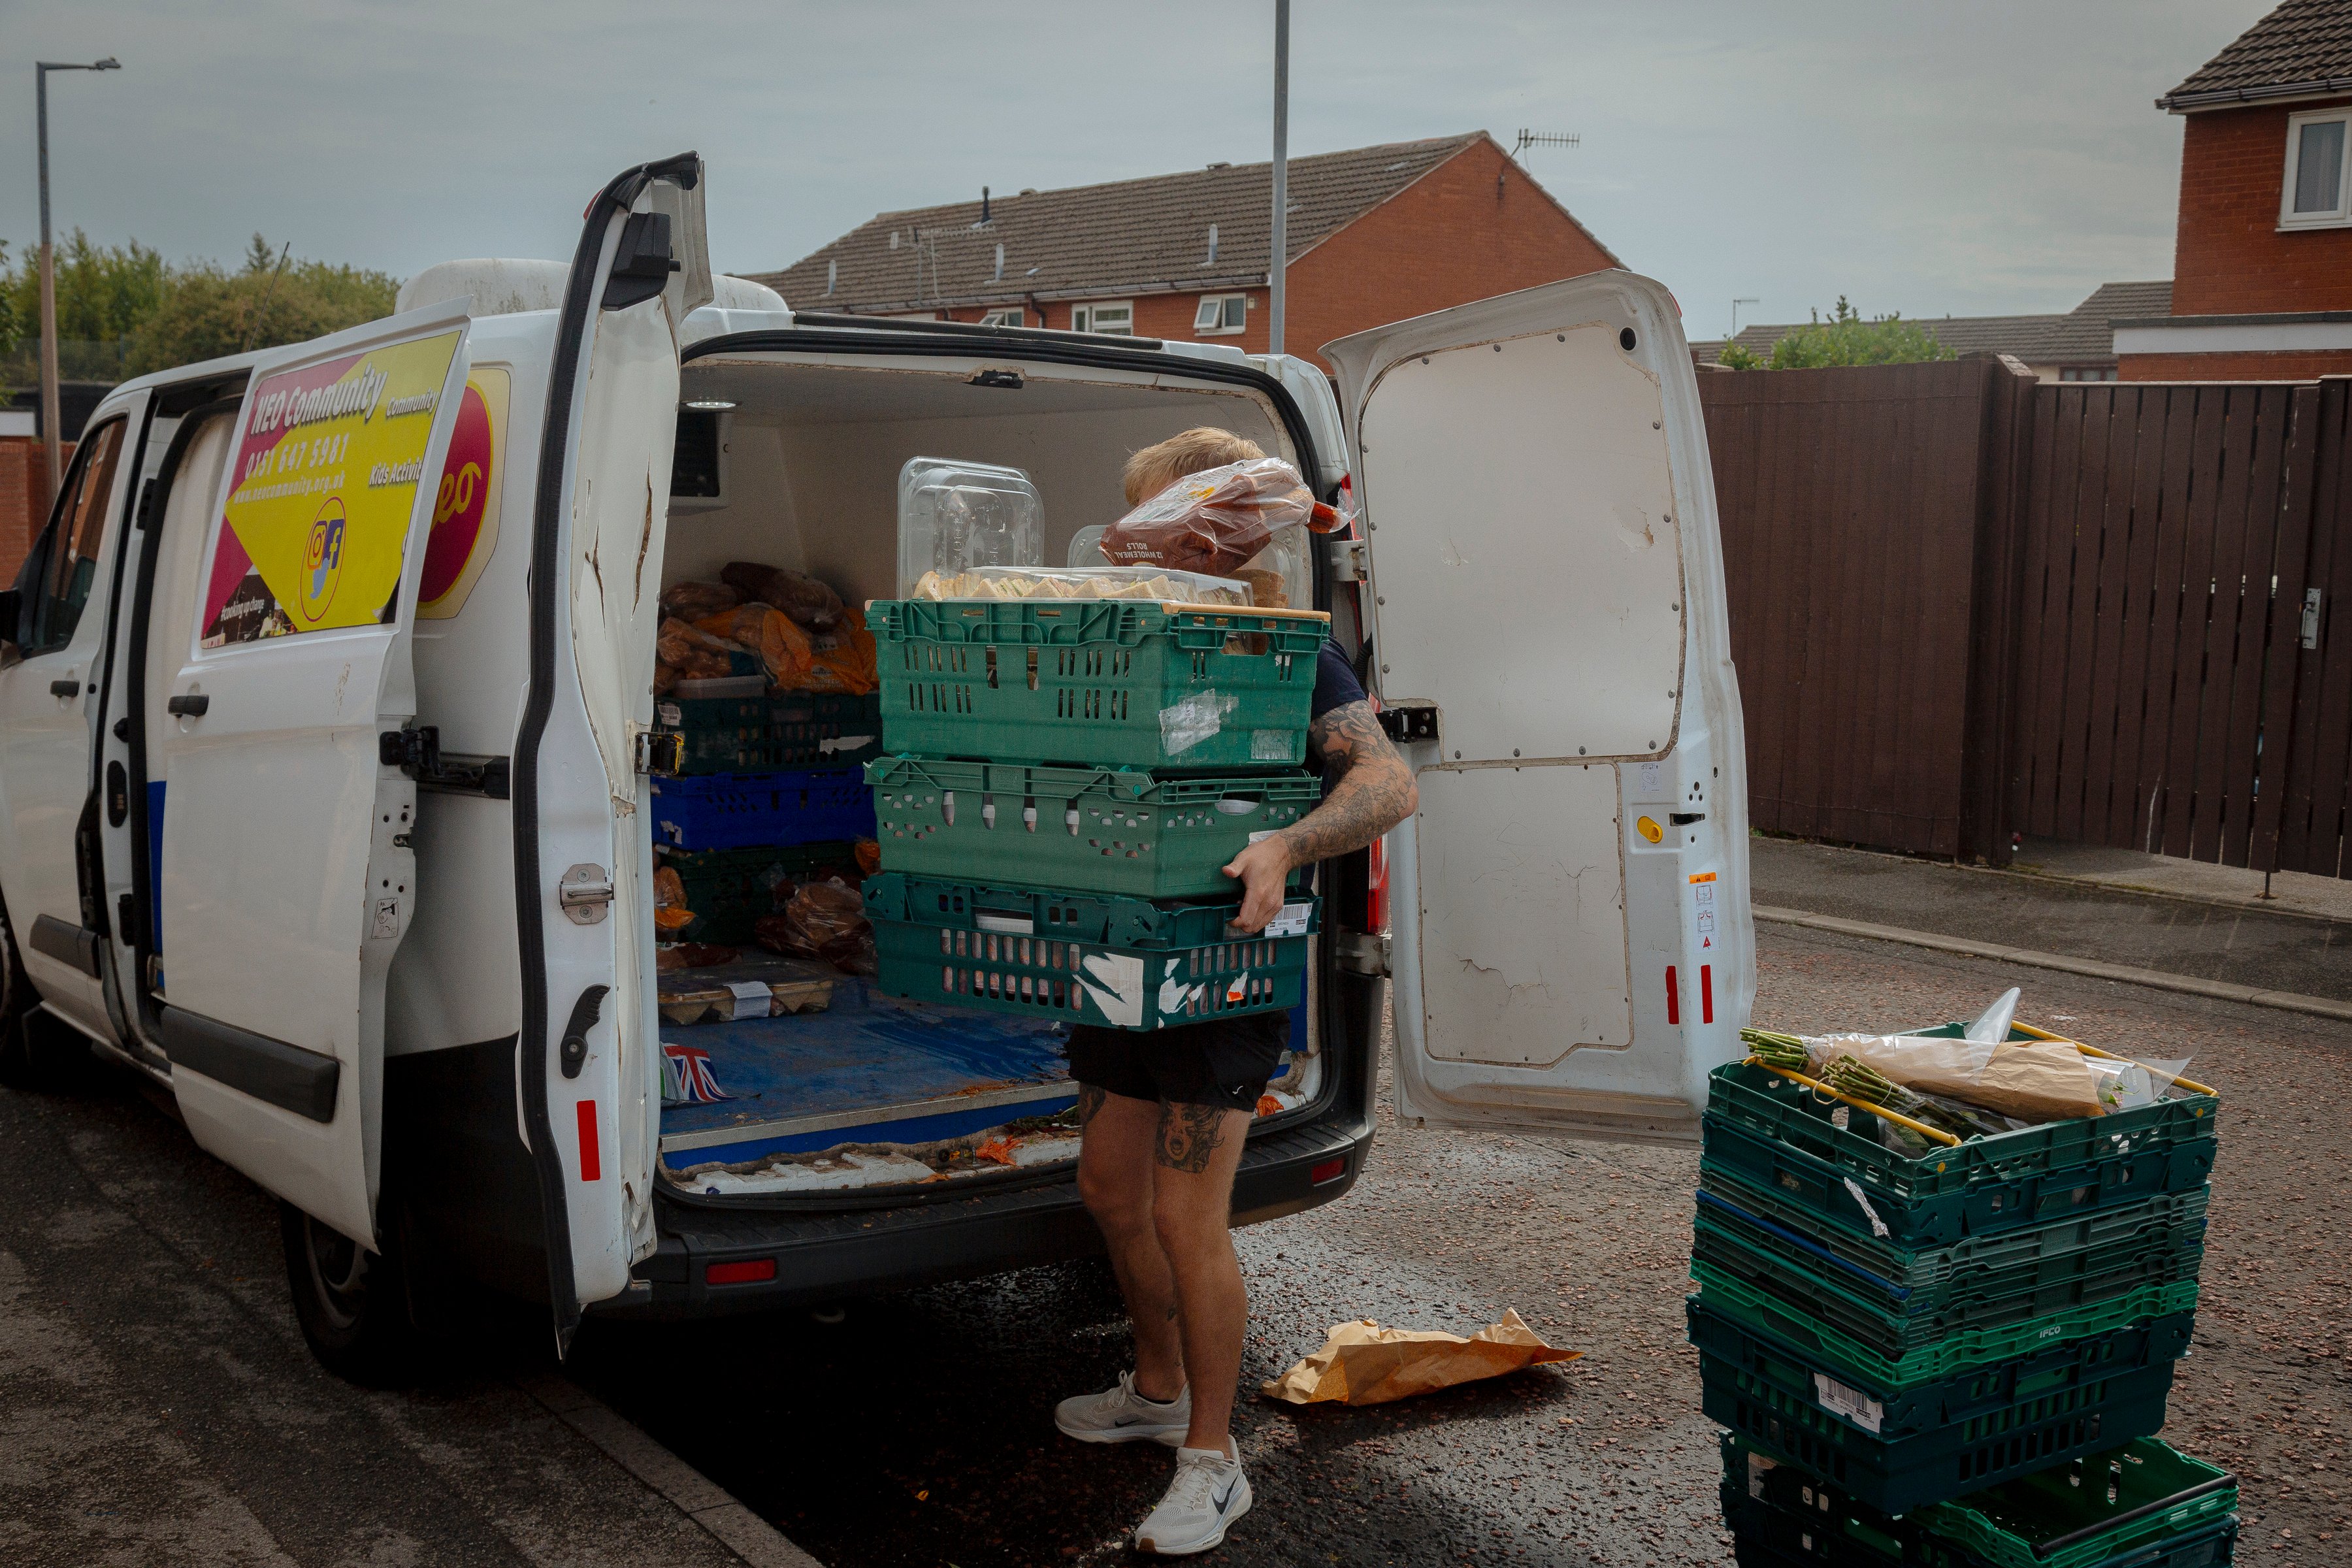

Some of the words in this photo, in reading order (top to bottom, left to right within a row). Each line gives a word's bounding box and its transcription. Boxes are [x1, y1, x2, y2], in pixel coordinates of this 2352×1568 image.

[250, 390, 286, 434] NEO
[284, 363, 388, 428] Community
[386, 387, 440, 417] Community
[245, 449, 276, 480] 0151
[278, 442, 308, 474] 647
[309, 433, 350, 468] 5981
[234, 470, 346, 504] www.neocommunity.org.uk
[368, 461, 390, 485] Kids
[431, 461, 482, 531] eo
[243, 601, 250, 616] up
[2039, 1326, 2061, 1339] IFCO
